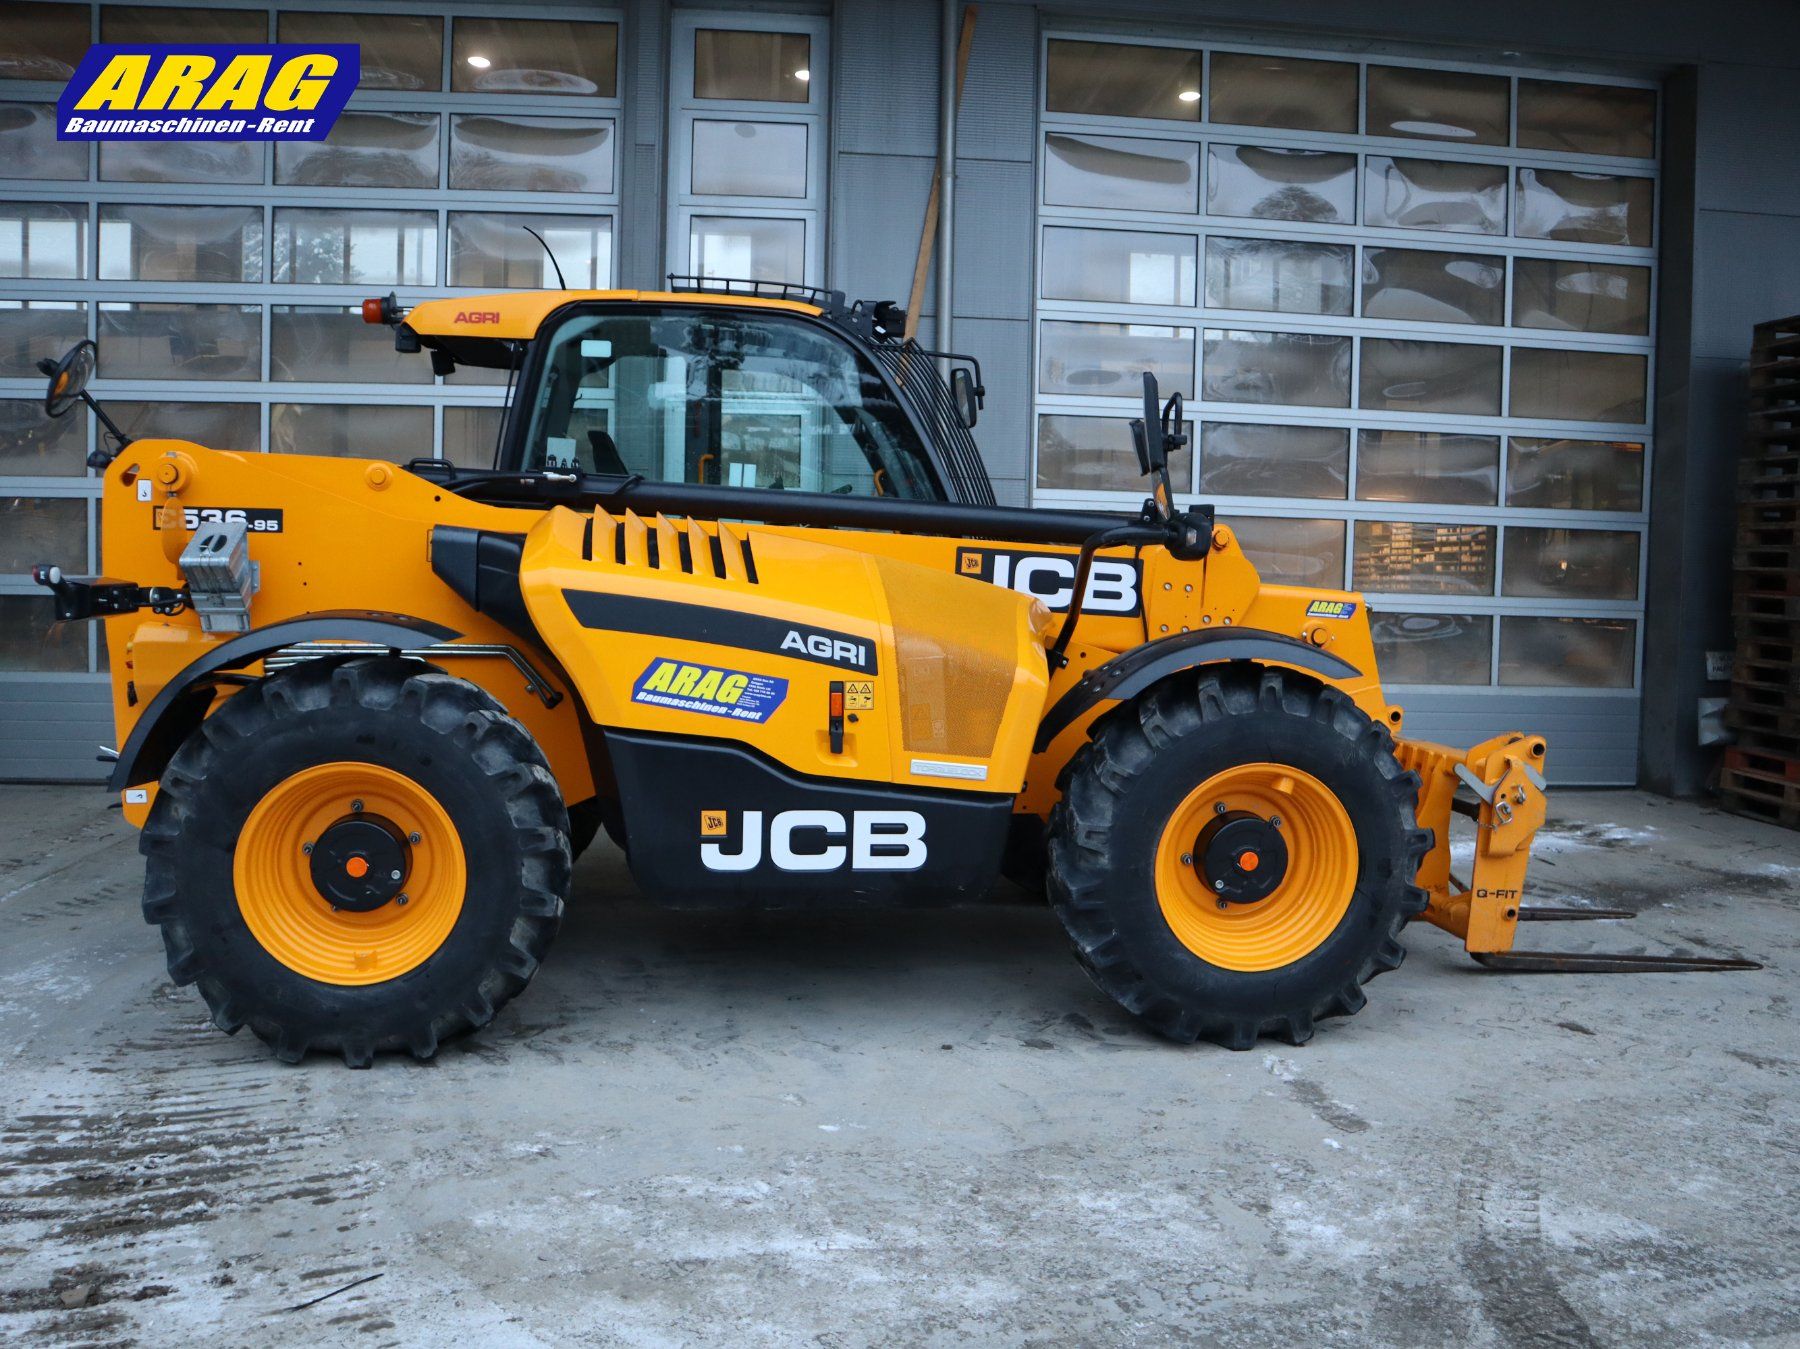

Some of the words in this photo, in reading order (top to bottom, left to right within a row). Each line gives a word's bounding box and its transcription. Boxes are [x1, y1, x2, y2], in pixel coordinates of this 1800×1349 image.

[454, 311, 500, 324] AGRI
[1309, 601, 1344, 614] ARAG
[780, 630, 866, 667] AGRI
[642, 661, 749, 705] ARAG
[701, 810, 928, 871] JCB
[1476, 889, 1518, 899] Q-FIT
